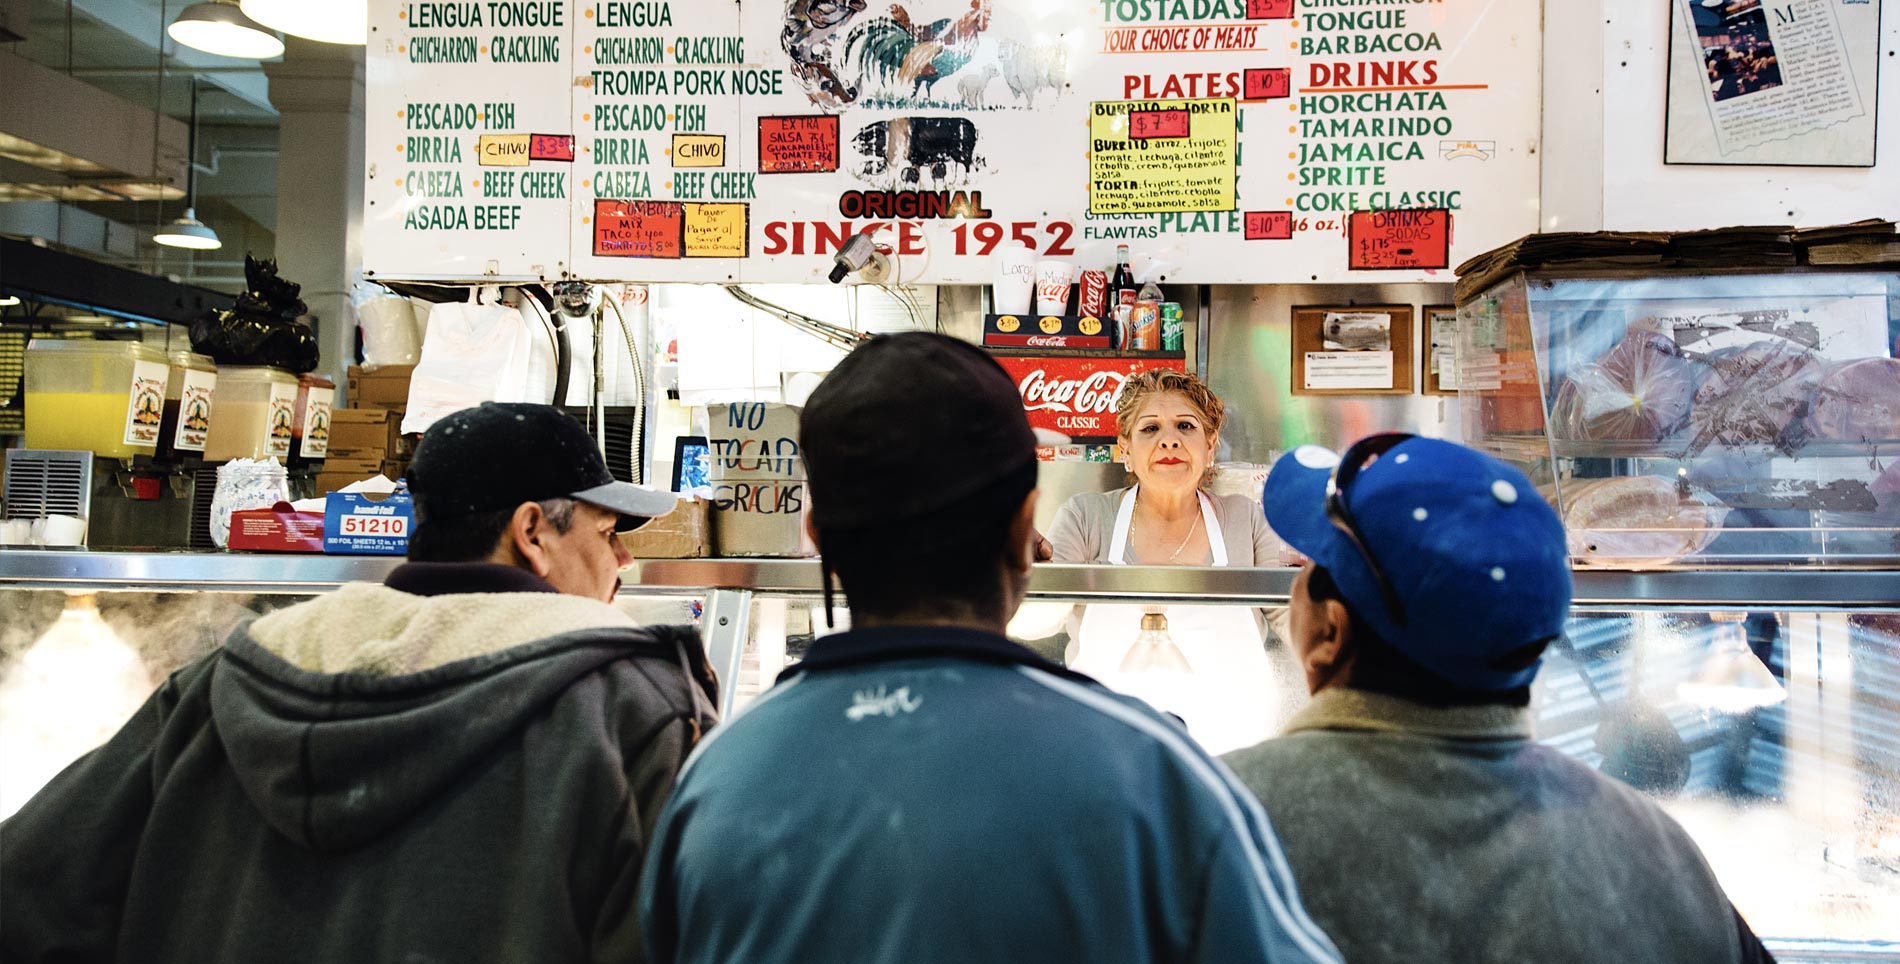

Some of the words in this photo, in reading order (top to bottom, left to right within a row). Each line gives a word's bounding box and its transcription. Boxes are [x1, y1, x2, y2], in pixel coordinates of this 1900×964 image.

[408, 3, 483, 28] LENGUA
[488, 2, 563, 27] TONGUE
[596, 2, 673, 27] LENGUA
[1101, 0, 1245, 22] TOSTADAS
[1302, 9, 1407, 32] TONGUE
[409, 36, 478, 63] CHICHARRON
[490, 36, 560, 63] CRACKLING
[594, 37, 664, 64] CHICHARRON
[674, 37, 745, 64] CRACKLING
[1103, 30, 1138, 51] YOUR
[1141, 28, 1190, 51] CHOICE
[1193, 28, 1211, 50] OF
[1214, 26, 1258, 49] MEATS
[1300, 32, 1442, 56] BARBACOA
[591, 70, 669, 95] TROMPA
[674, 70, 726, 95] PORK
[732, 70, 783, 95] NOSE
[1124, 72, 1240, 99] PLATES
[1309, 60, 1438, 88] DRINKS
[1300, 91, 1447, 115] HORCHATA
[407, 103, 477, 130] PESCADO
[484, 103, 515, 130] FISH
[595, 104, 666, 131] PESCADO
[674, 104, 706, 131] FISH
[781, 118, 820, 130] EXTRA
[1299, 116, 1453, 138] TAMARINDO
[407, 136, 462, 163] BIRRIA
[769, 131, 803, 143] SALSA
[594, 138, 650, 165] BIRRIA
[679, 143, 720, 158] CHIVO
[1298, 141, 1425, 166] JAMAICA
[406, 170, 464, 198] CABEZA
[484, 171, 516, 198] BEEF
[520, 171, 566, 199] CHEEK
[594, 171, 652, 198] CABEZA
[673, 172, 706, 199] BEEF
[710, 172, 757, 199] CHEEK
[1299, 166, 1386, 186] SPRITE
[840, 191, 991, 218] ORIGINAL
[1295, 192, 1360, 212] COKE
[1368, 190, 1462, 213] CLASSIC
[405, 206, 469, 230] ASADA
[474, 206, 521, 230] BEEF
[619, 219, 642, 229] MIX
[1159, 208, 1241, 233] PLATE
[1292, 217, 1308, 232] 16
[1315, 219, 1339, 230] oz.
[1373, 211, 1435, 228] DRINKS
[600, 229, 631, 240] TACO
[951, 221, 1075, 255] 1952
[1084, 226, 1158, 239] FLAWTAS
[1386, 227, 1431, 240] SODAS
[1161, 318, 1184, 339] Spri
[1026, 336, 1068, 347] Coca-Cola
[1018, 369, 1126, 413] Coca-Col
[729, 402, 765, 431] NO
[1056, 416, 1100, 429] CLASSIC
[710, 437, 799, 475] TOCAR
[713, 479, 803, 514] GRACIAS
[345, 518, 403, 533] 51210
